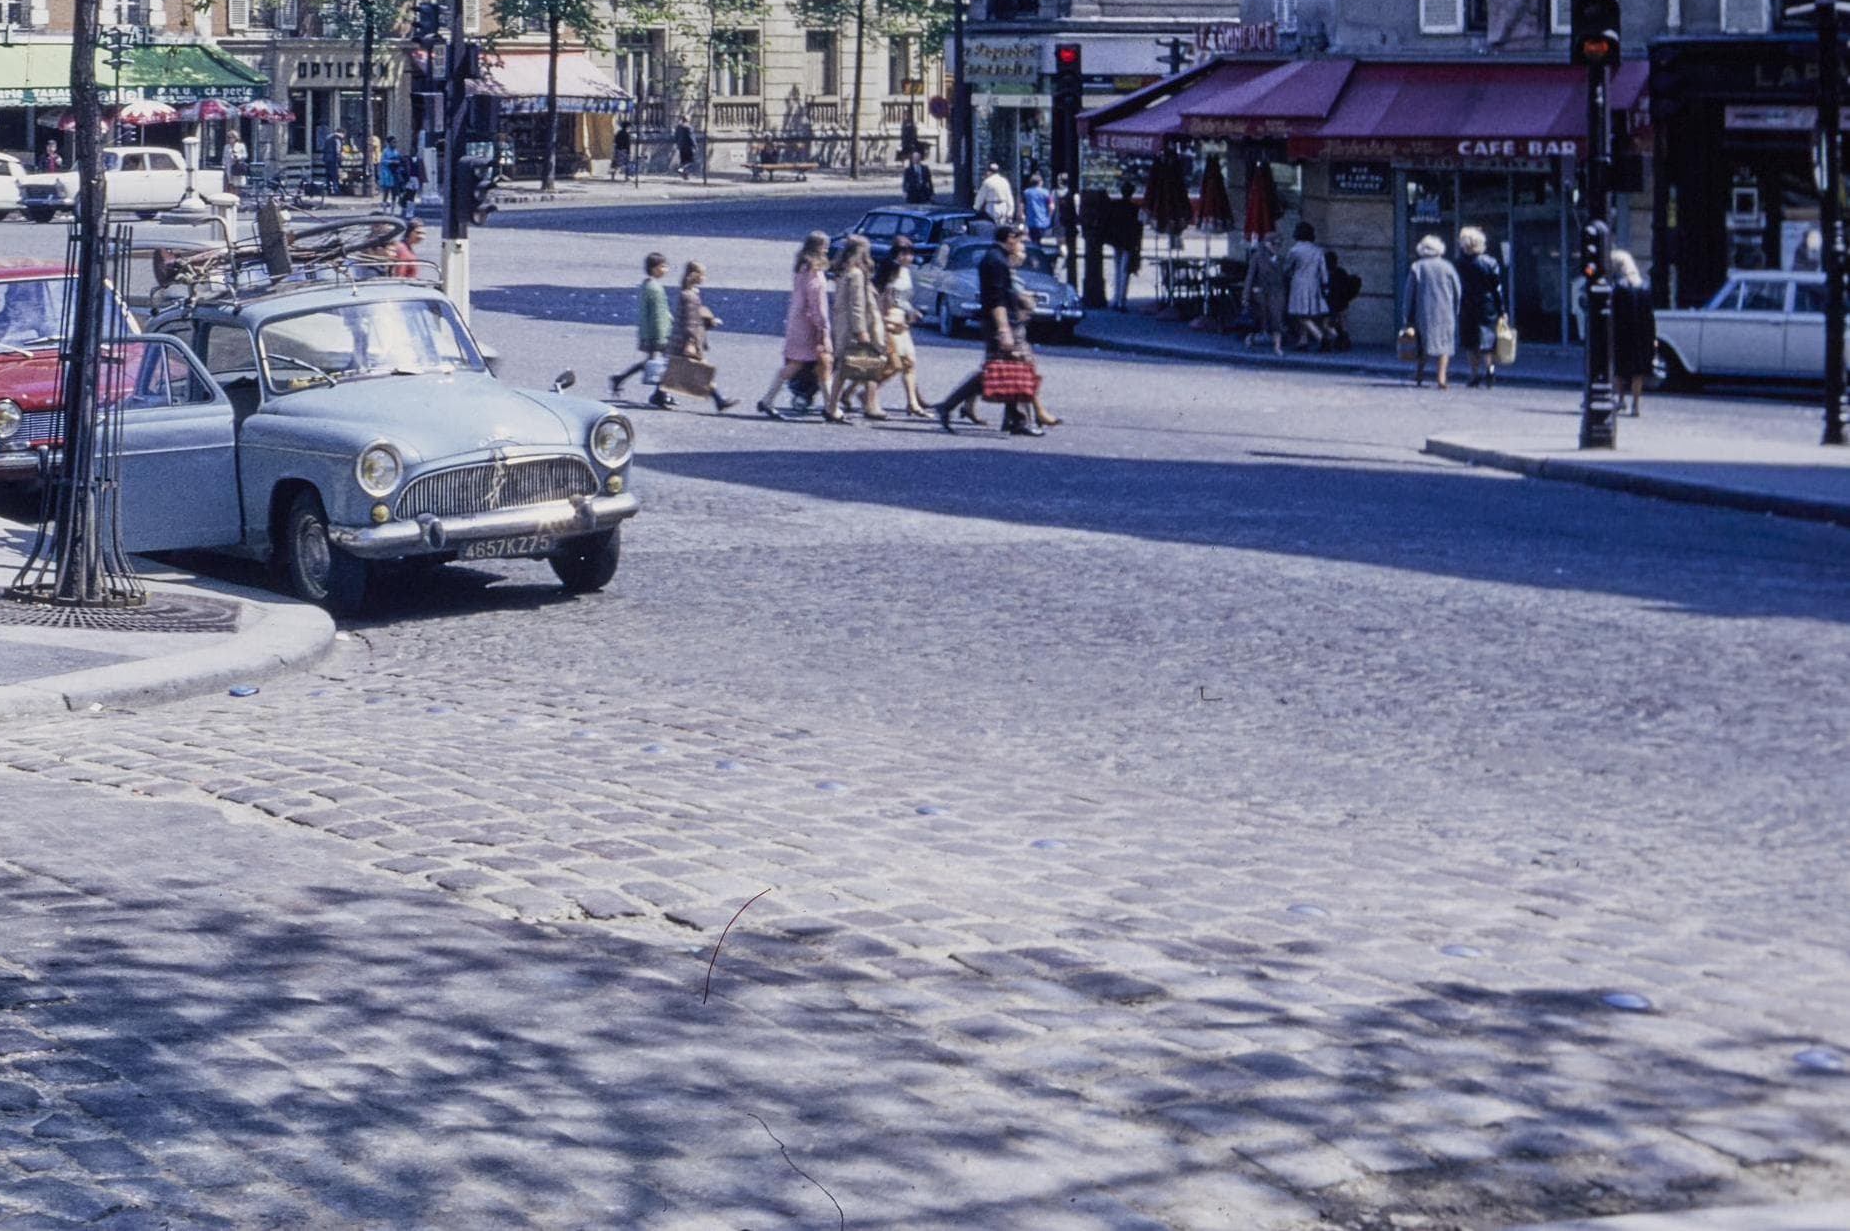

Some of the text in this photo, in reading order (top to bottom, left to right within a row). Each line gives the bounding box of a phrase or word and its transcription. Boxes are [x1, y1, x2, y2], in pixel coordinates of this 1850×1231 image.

[297, 62, 390, 79] OPTICIN
[97, 86, 145, 101] ariel
[1528, 140, 1577, 156] BAR
